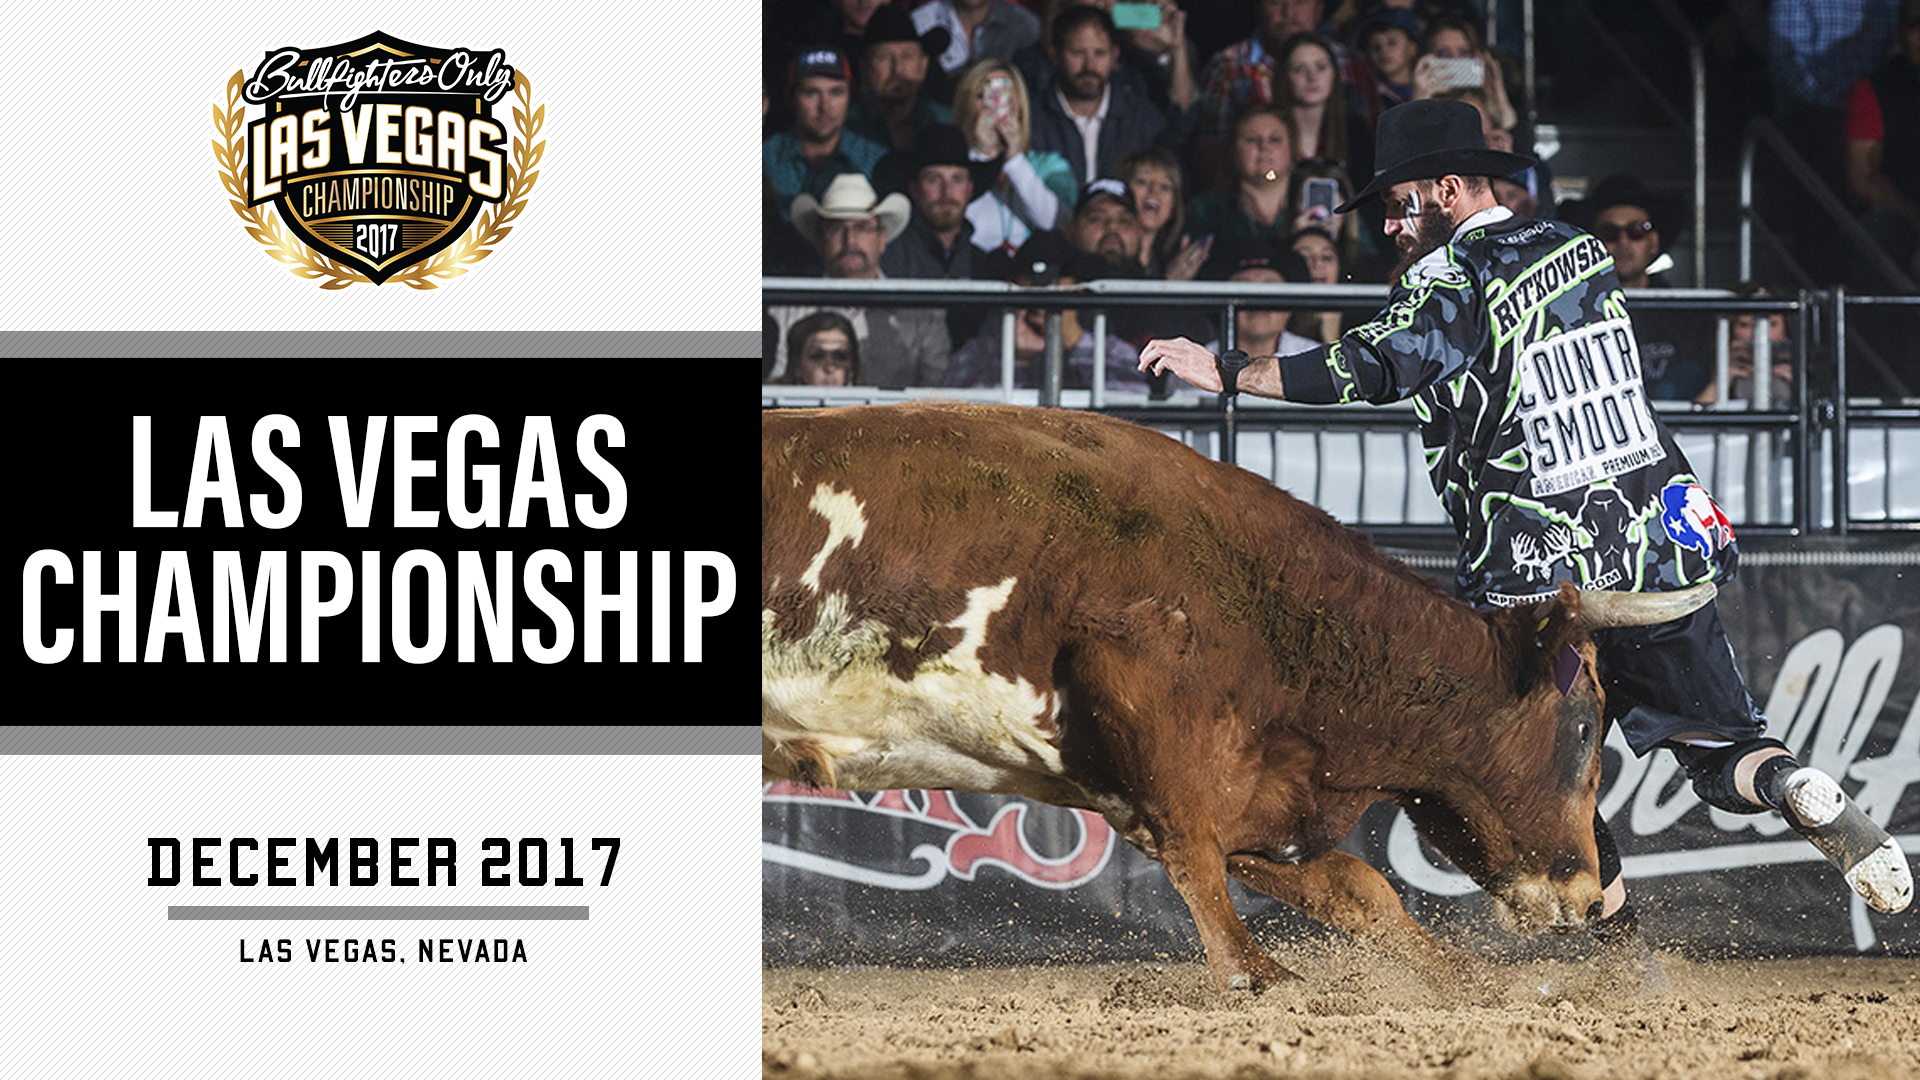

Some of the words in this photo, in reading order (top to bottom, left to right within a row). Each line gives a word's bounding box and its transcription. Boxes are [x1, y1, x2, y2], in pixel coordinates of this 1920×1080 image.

[1519, 327, 1639, 411] COUNTR
[1530, 387, 1650, 471] SMOOT
[1601, 448, 1651, 475] PREMIUM
